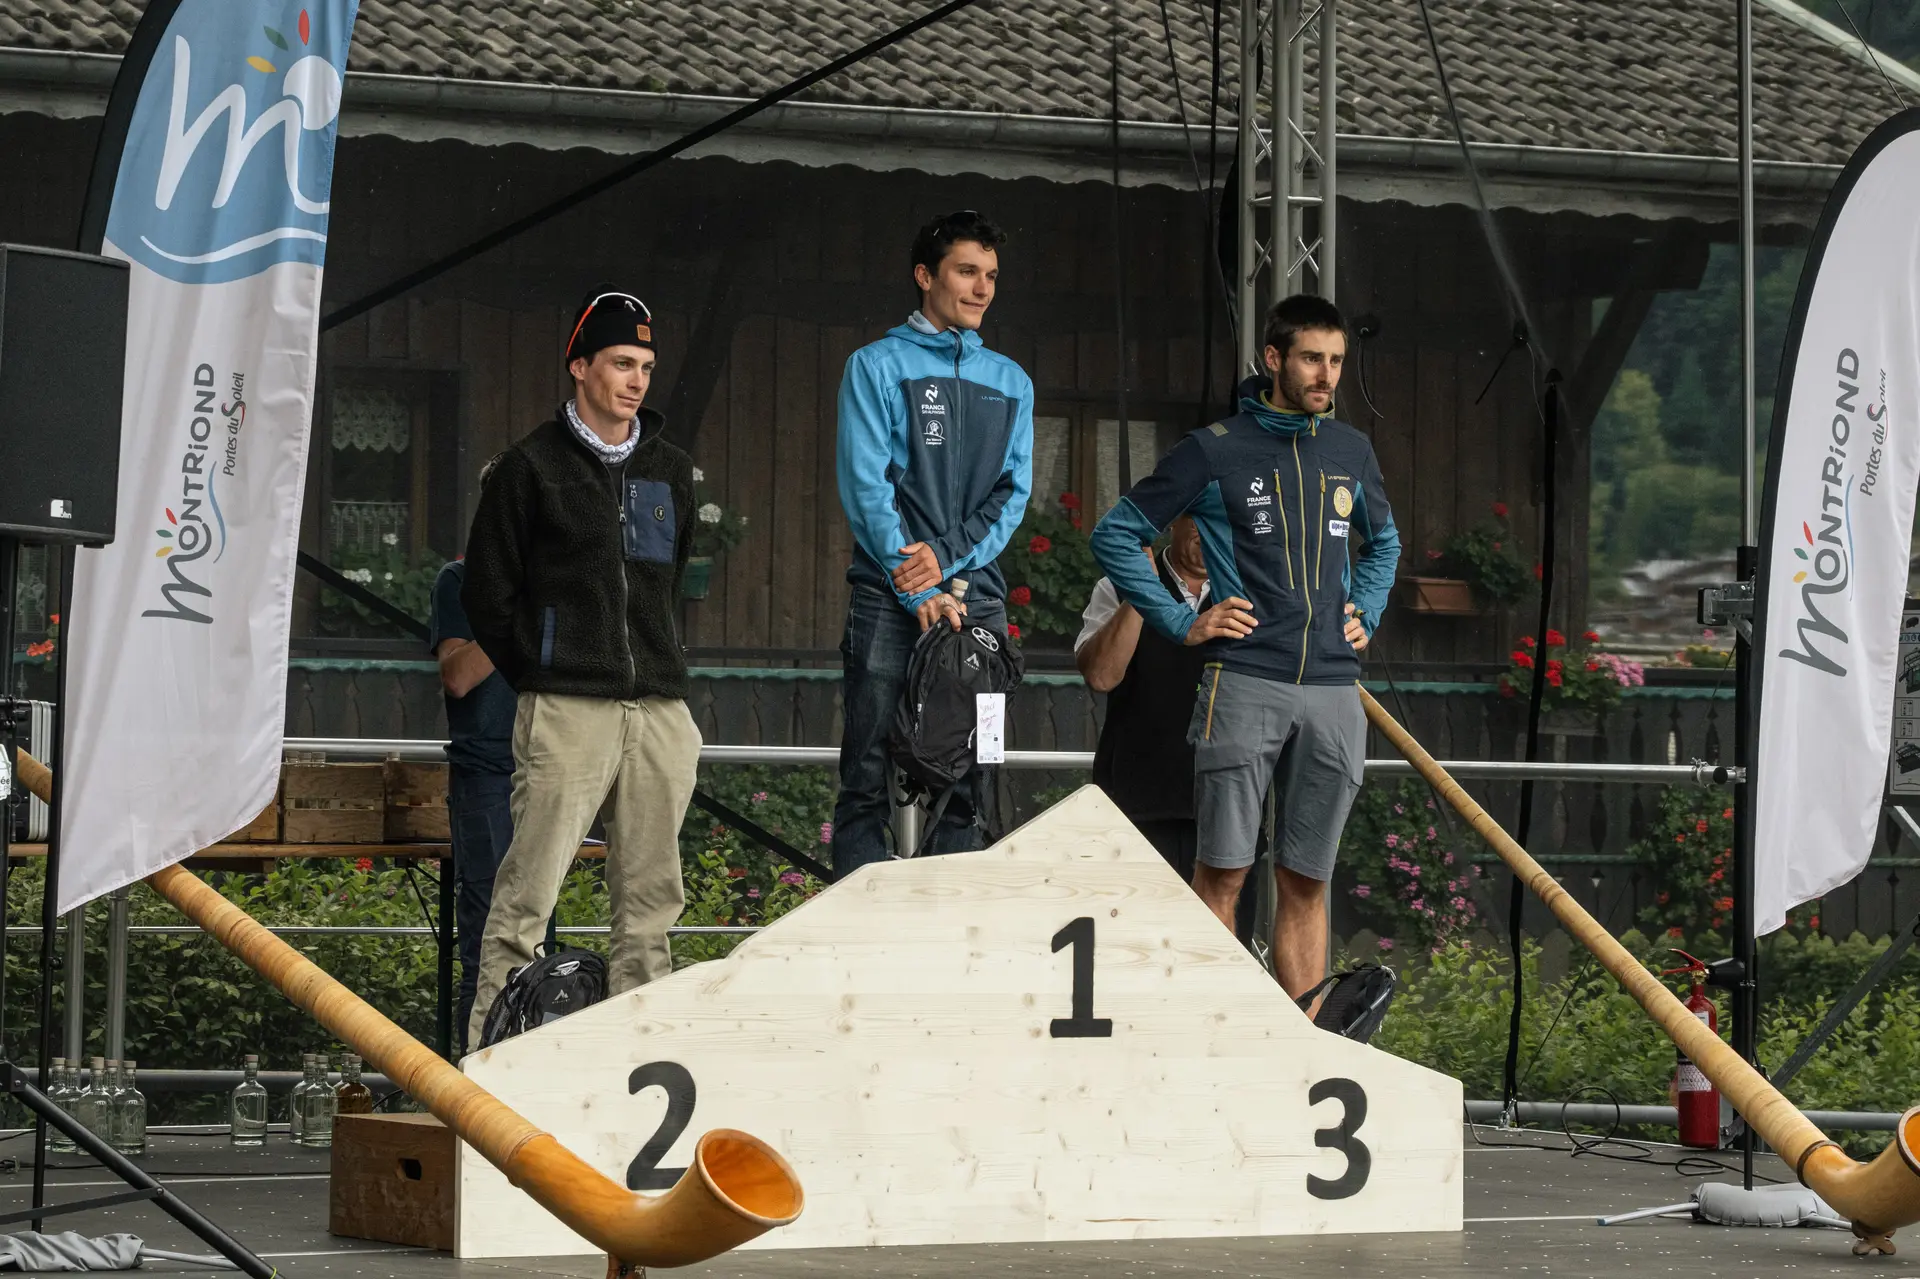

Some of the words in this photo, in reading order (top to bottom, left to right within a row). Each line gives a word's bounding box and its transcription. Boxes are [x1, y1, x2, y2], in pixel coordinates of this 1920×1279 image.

[221, 372, 247, 420] Soleil
[1867, 369, 1887, 421] Soleil
[229, 418, 240, 434] du
[1873, 422, 1885, 446] du
[223, 435, 238, 477] Portes
[1860, 446, 1882, 497] Portes
[1247, 495, 1271, 503] FRANCE
[1050, 916, 1112, 1038] 1
[626, 1061, 697, 1191] 2
[1306, 1077, 1371, 1200] 3
